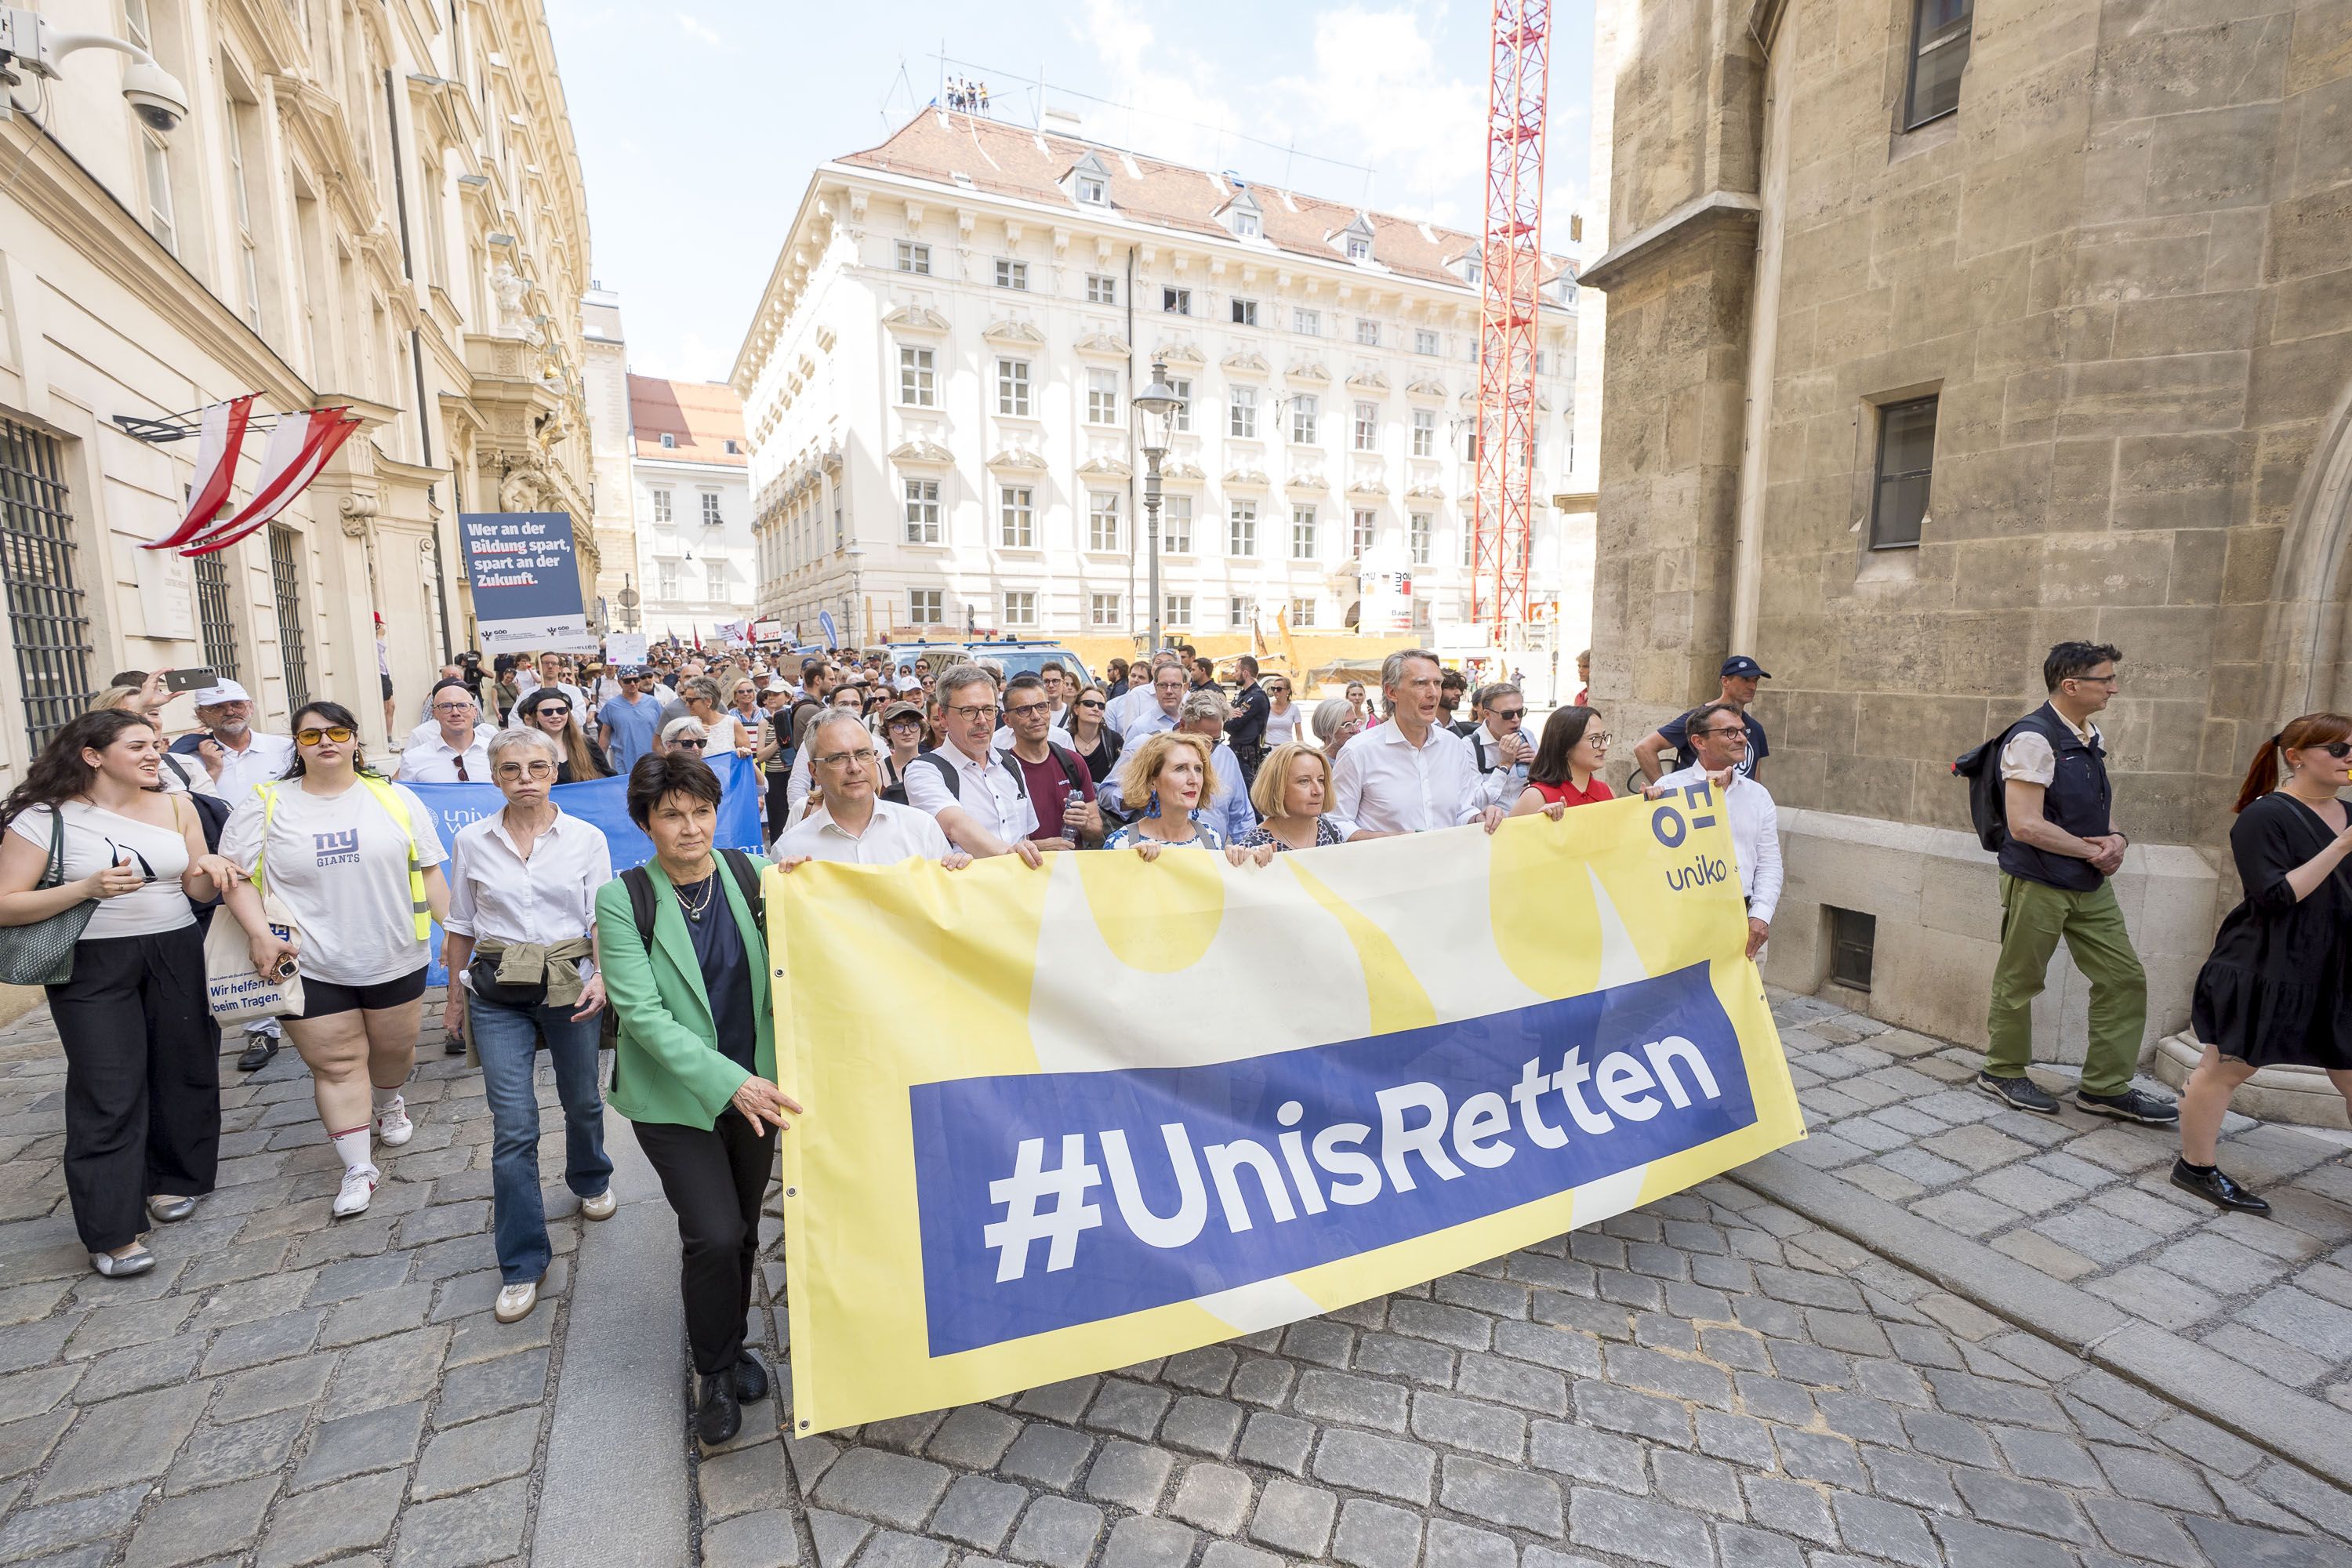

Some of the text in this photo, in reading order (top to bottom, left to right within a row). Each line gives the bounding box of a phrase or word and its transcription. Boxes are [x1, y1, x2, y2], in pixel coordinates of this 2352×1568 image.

[467, 521, 546, 535] Wer an der
[470, 539, 571, 555] Bildung spart,
[474, 554, 560, 572] spart an der
[477, 572, 539, 587] Zukunft.
[317, 853, 360, 868] GIANTS
[1666, 855, 1726, 891] uniko
[210, 984, 228, 996] Wir
[231, 979, 265, 993] helfen
[212, 993, 281, 1012] beim Tragen.
[983, 1034, 1721, 1284] #UnisRetten
